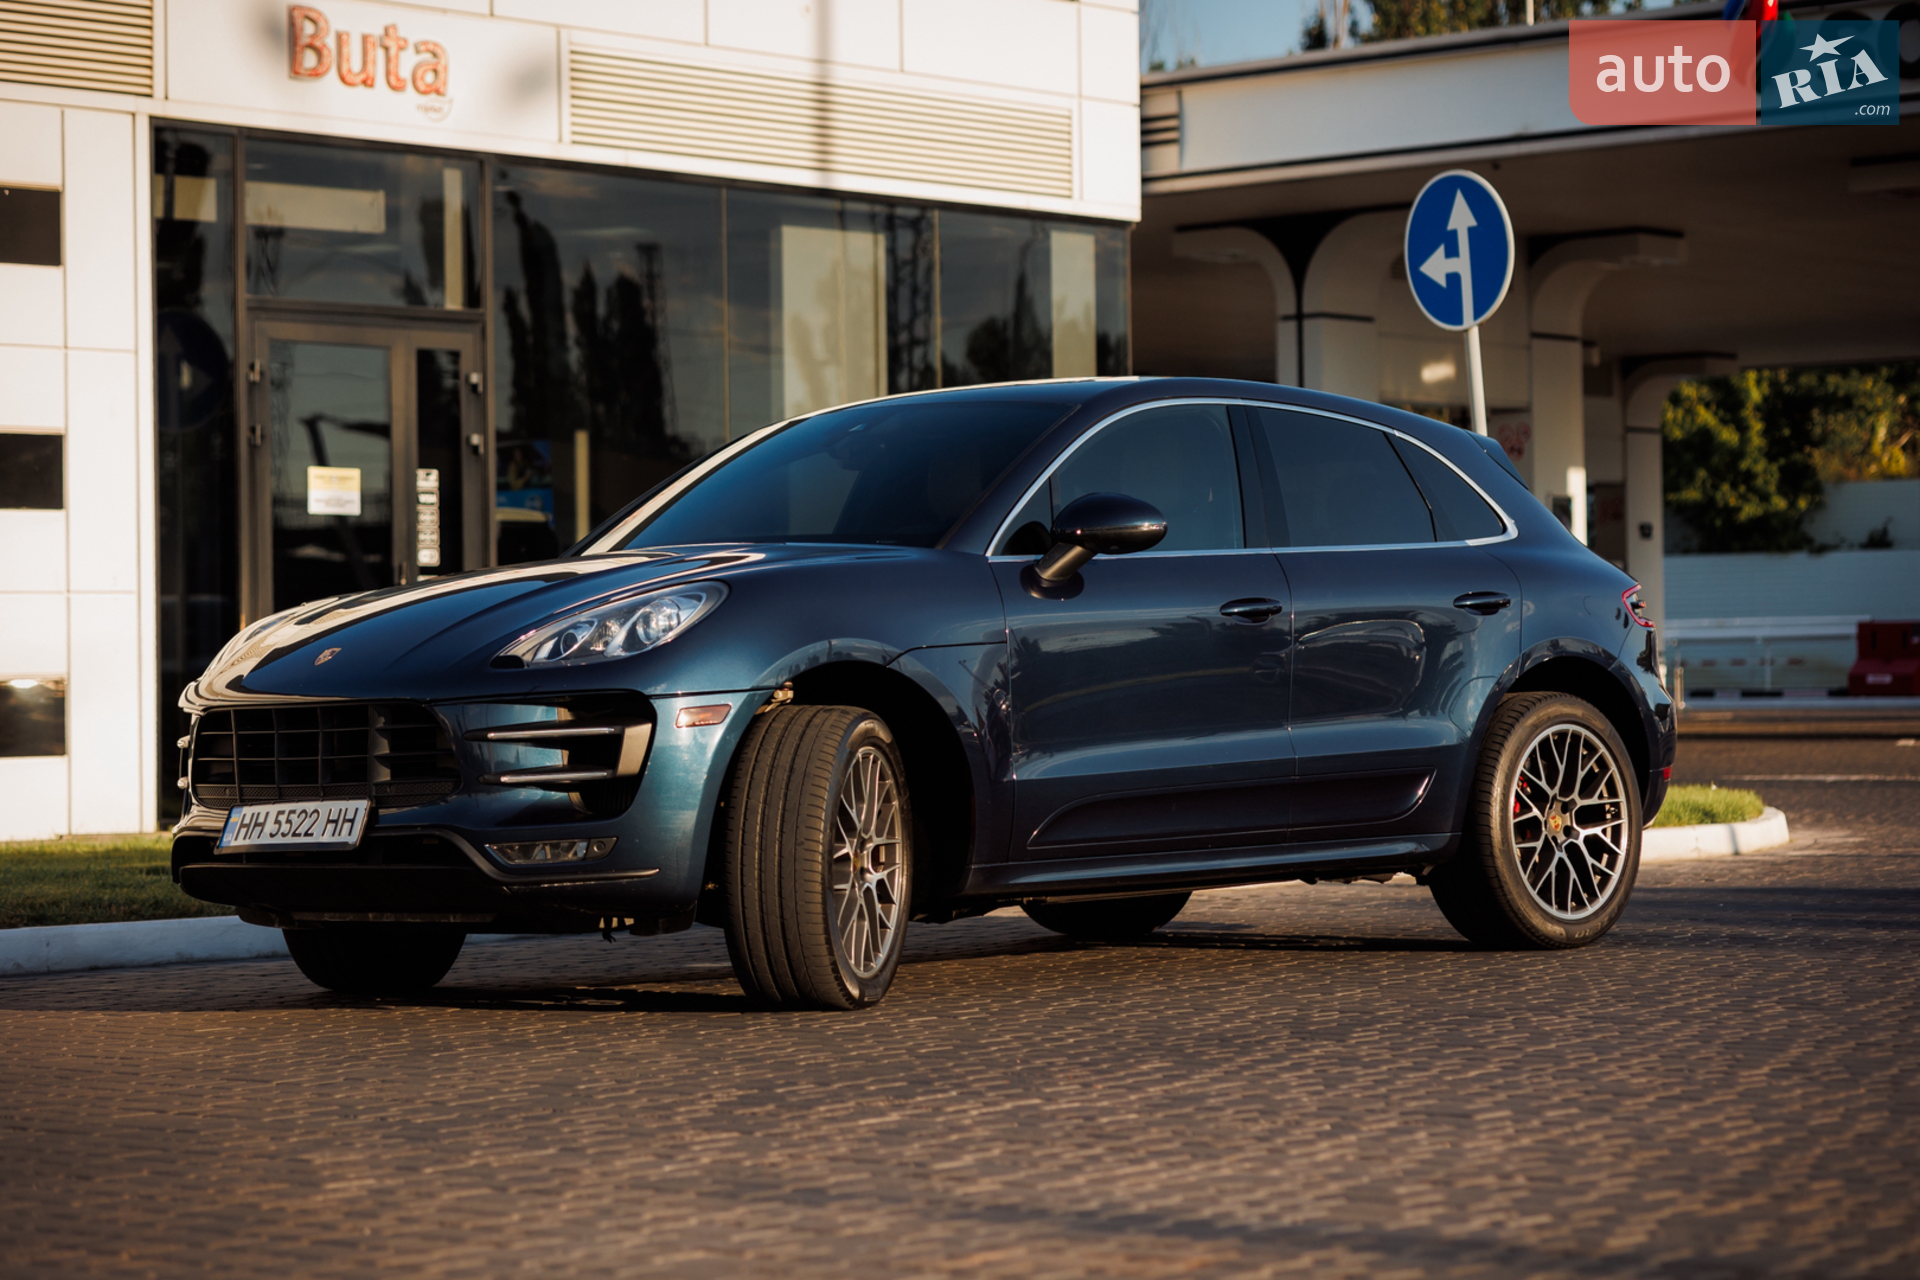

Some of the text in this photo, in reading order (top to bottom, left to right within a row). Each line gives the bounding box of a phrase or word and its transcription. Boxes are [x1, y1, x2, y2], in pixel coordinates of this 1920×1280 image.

[287, 4, 449, 96] Buta
[234, 807, 359, 842] HH 5522 HH
